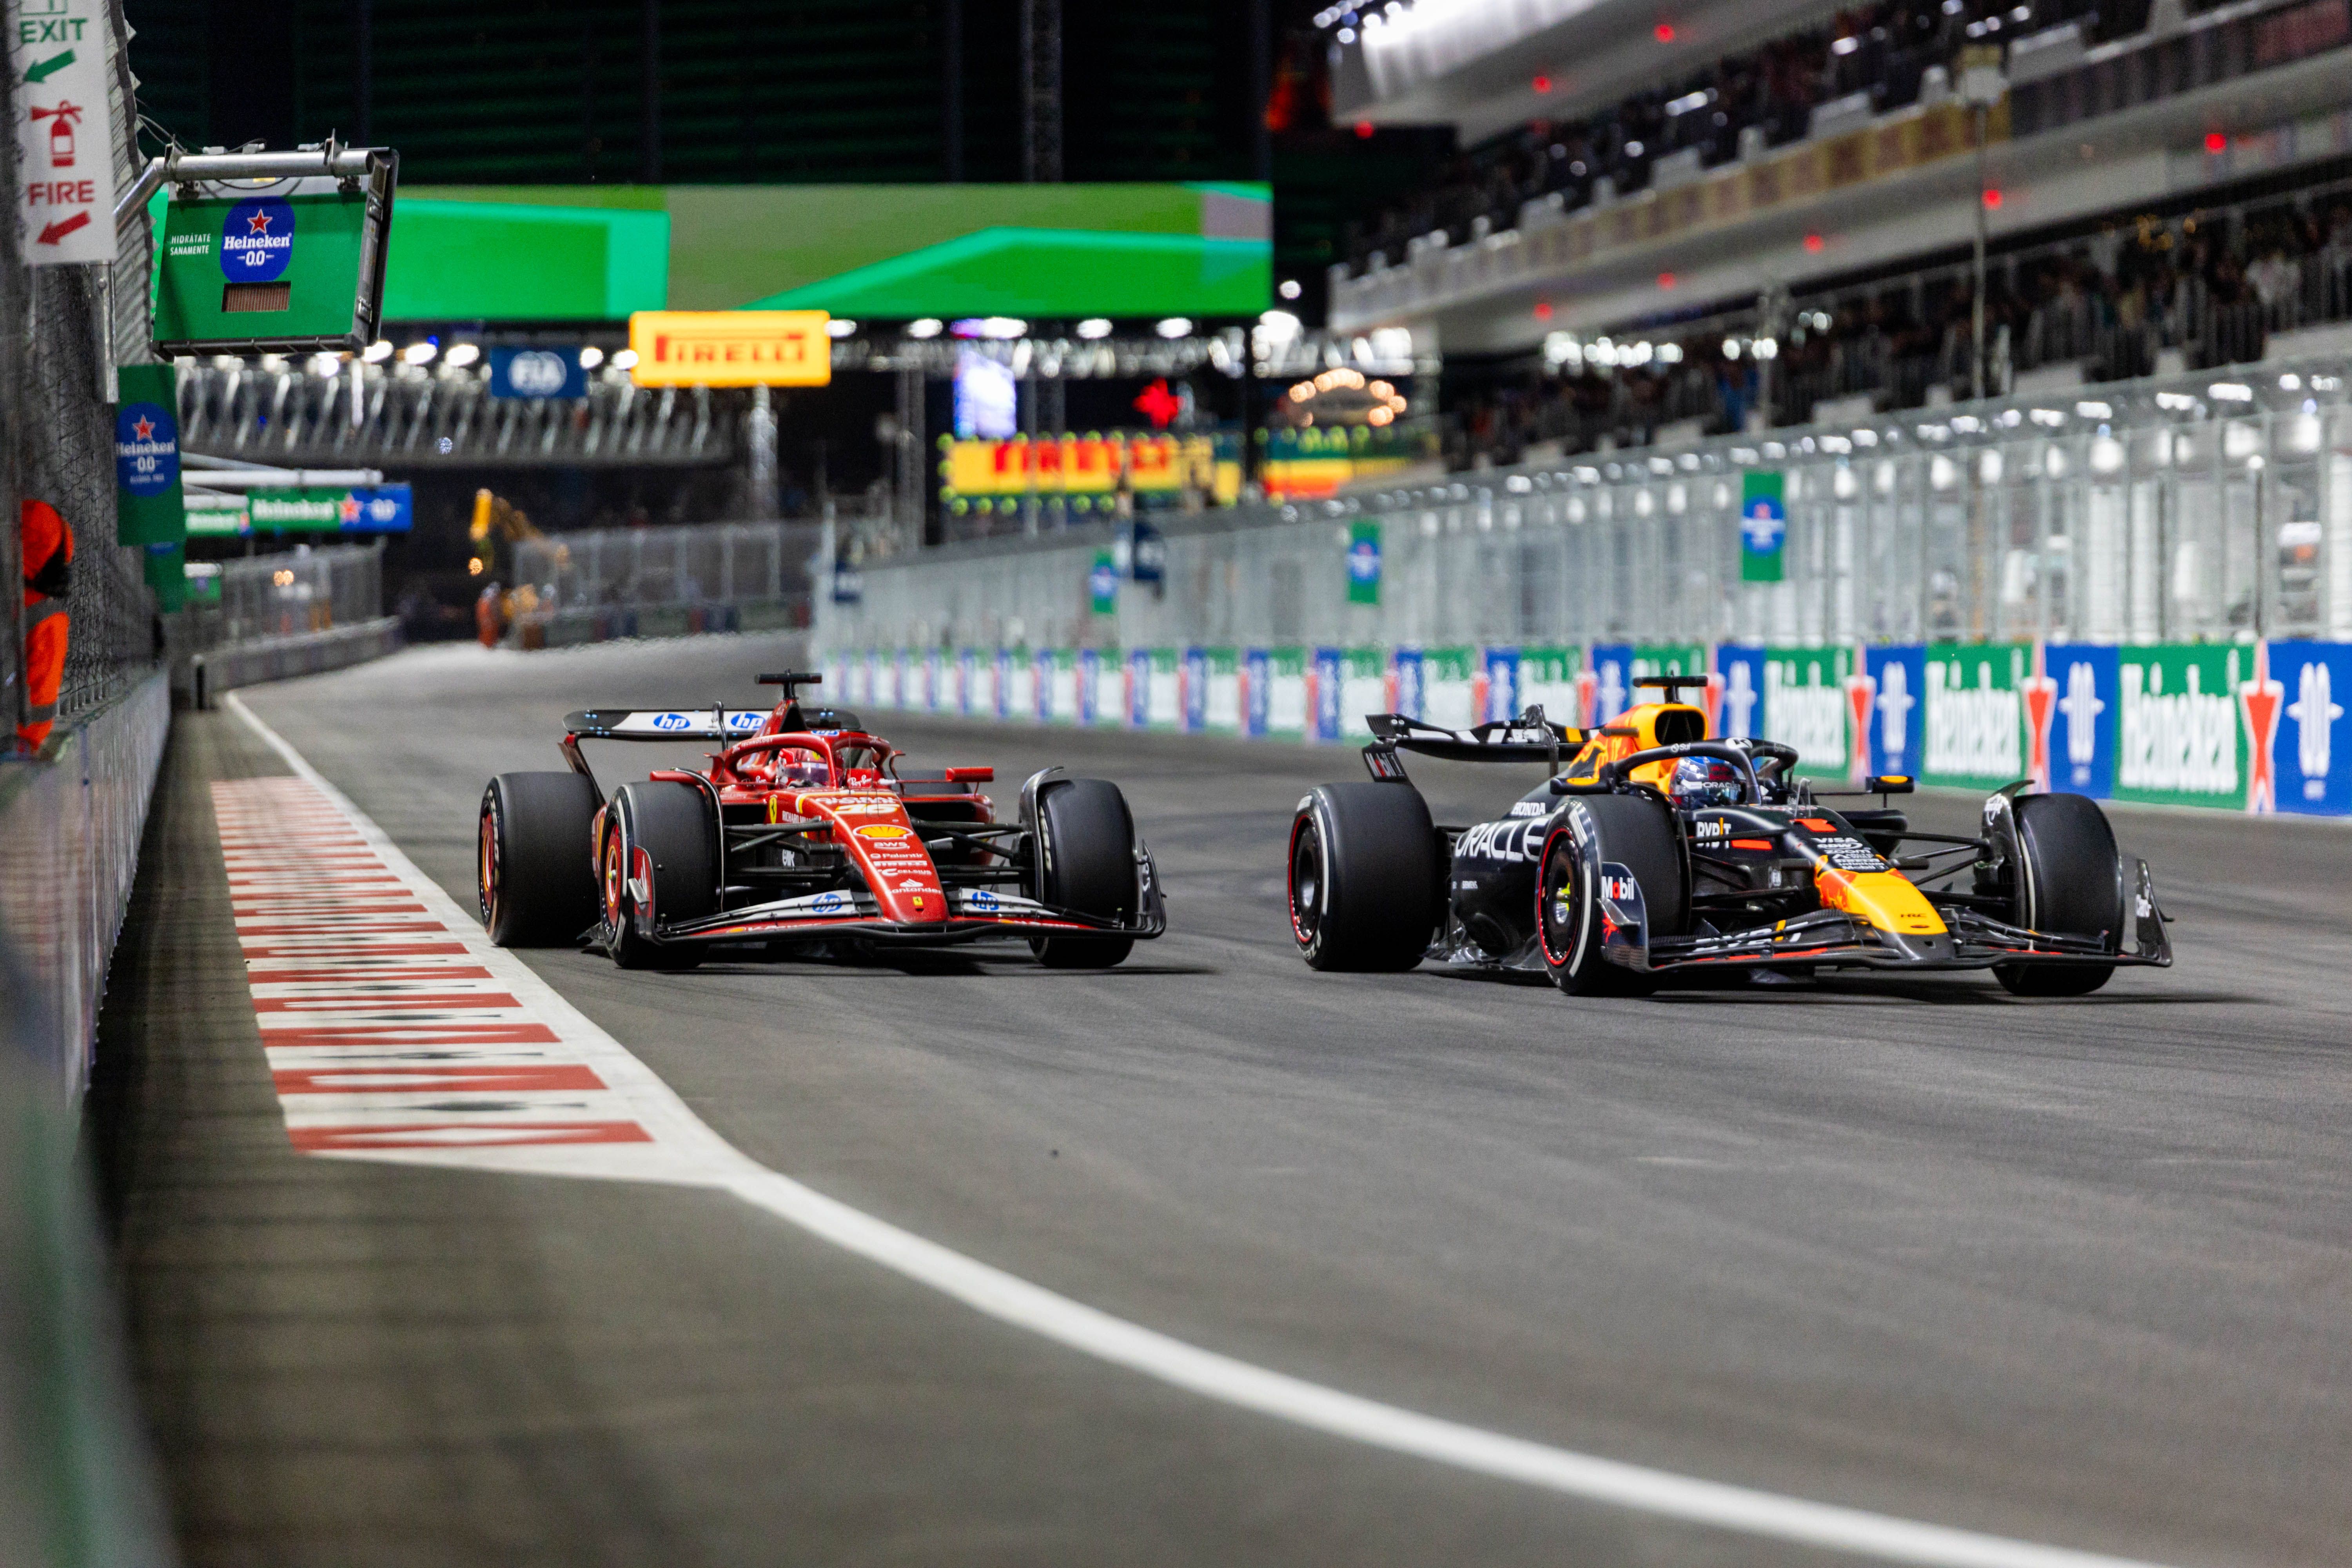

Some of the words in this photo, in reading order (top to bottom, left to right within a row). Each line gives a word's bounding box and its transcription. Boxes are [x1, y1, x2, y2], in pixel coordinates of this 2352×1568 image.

[20, 18, 88, 43] EXIT
[28, 179, 94, 205] FIRE
[171, 233, 211, 244] HIDRÁTATE
[223, 234, 291, 250] Heineken
[170, 245, 209, 256] SANAMENTE
[654, 333, 806, 363] PIRELLI
[116, 439, 175, 458] Heineken
[659, 713, 687, 730] hp
[736, 712, 764, 730] hp
[1365, 753, 1397, 777] Mobil
[782, 810, 799, 824] RICHARD
[833, 804, 900, 814] 16
[1510, 802, 1546, 817] HONDA
[1454, 817, 1550, 862] ORACLE
[1601, 876, 1635, 900] Mobil
